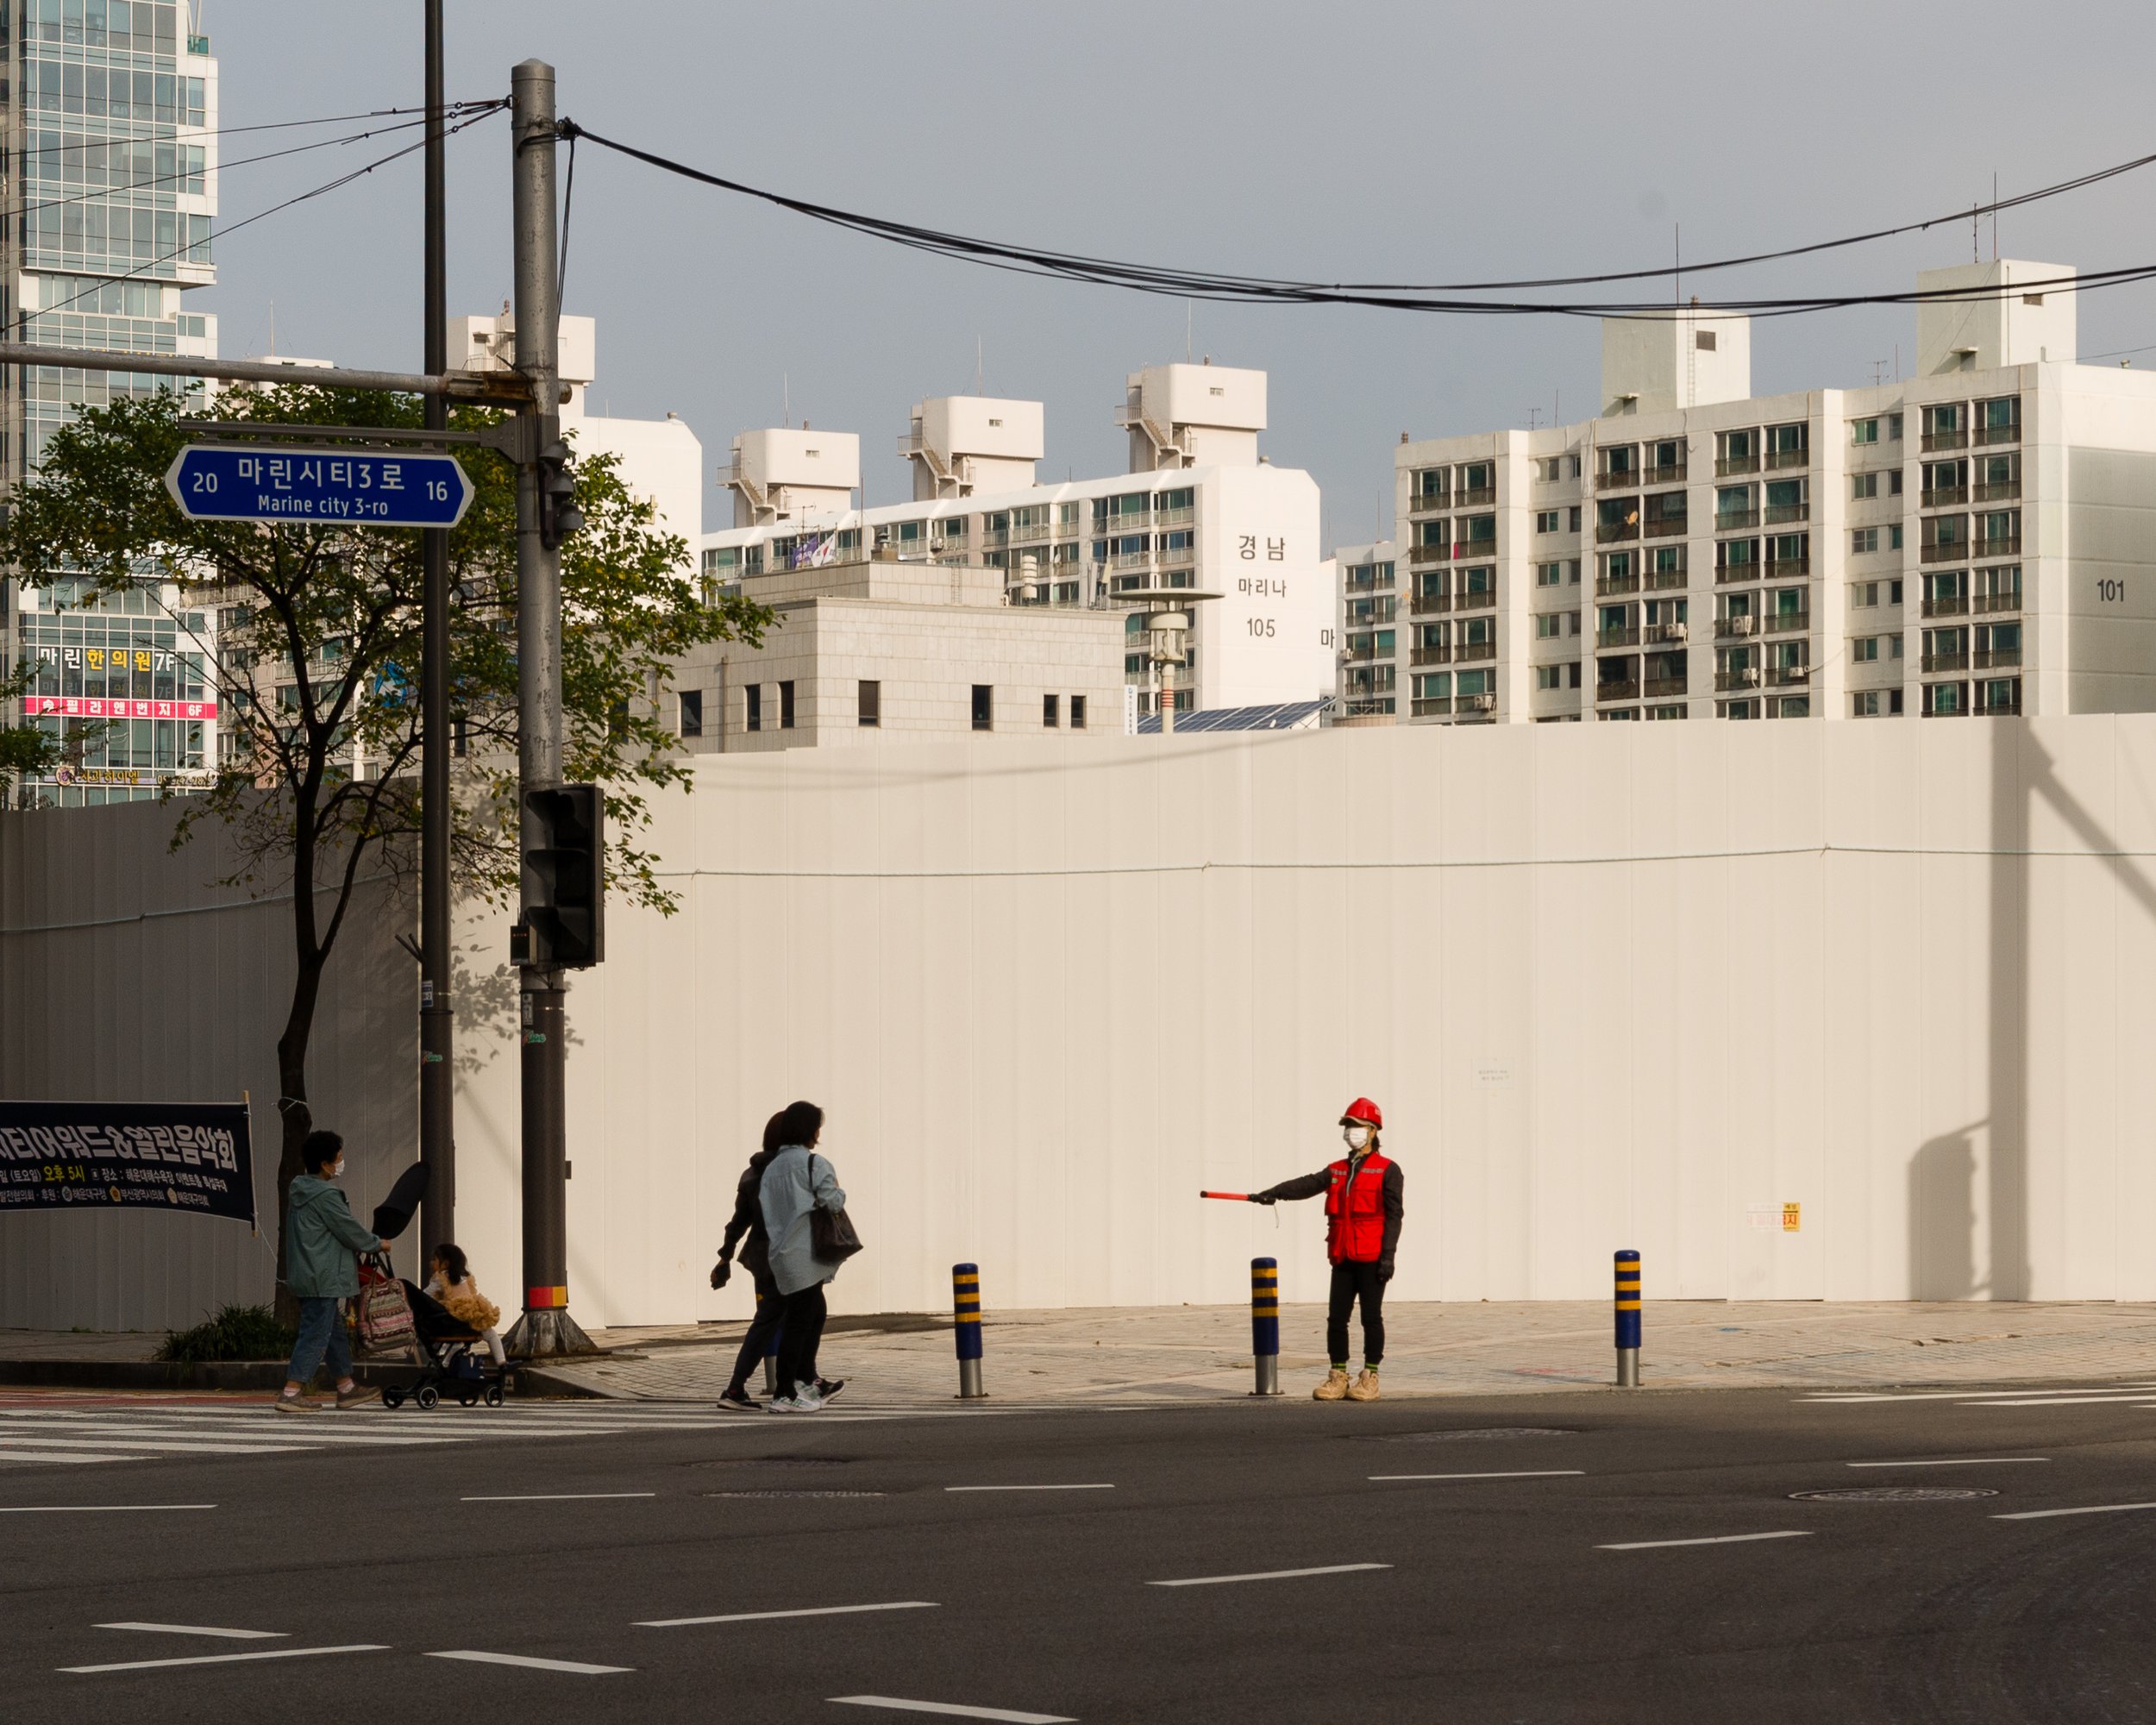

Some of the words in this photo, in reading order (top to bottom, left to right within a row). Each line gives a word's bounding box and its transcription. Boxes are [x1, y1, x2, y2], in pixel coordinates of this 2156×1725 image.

[192, 472, 218, 493] 20
[238, 458, 405, 491] 마린시티3로
[426, 480, 448, 501] 16
[258, 494, 312, 513] Marine
[319, 497, 349, 517] city
[355, 498, 388, 516] 3-ro
[1238, 535, 1286, 561] 경남
[1238, 577, 1287, 599] 마리나
[2096, 579, 2124, 603] 101
[1246, 617, 1276, 638] 105
[188, 704, 203, 717] 6F
[44, 1164, 66, 1183] 오후
[68, 1164, 85, 1182] 5시
